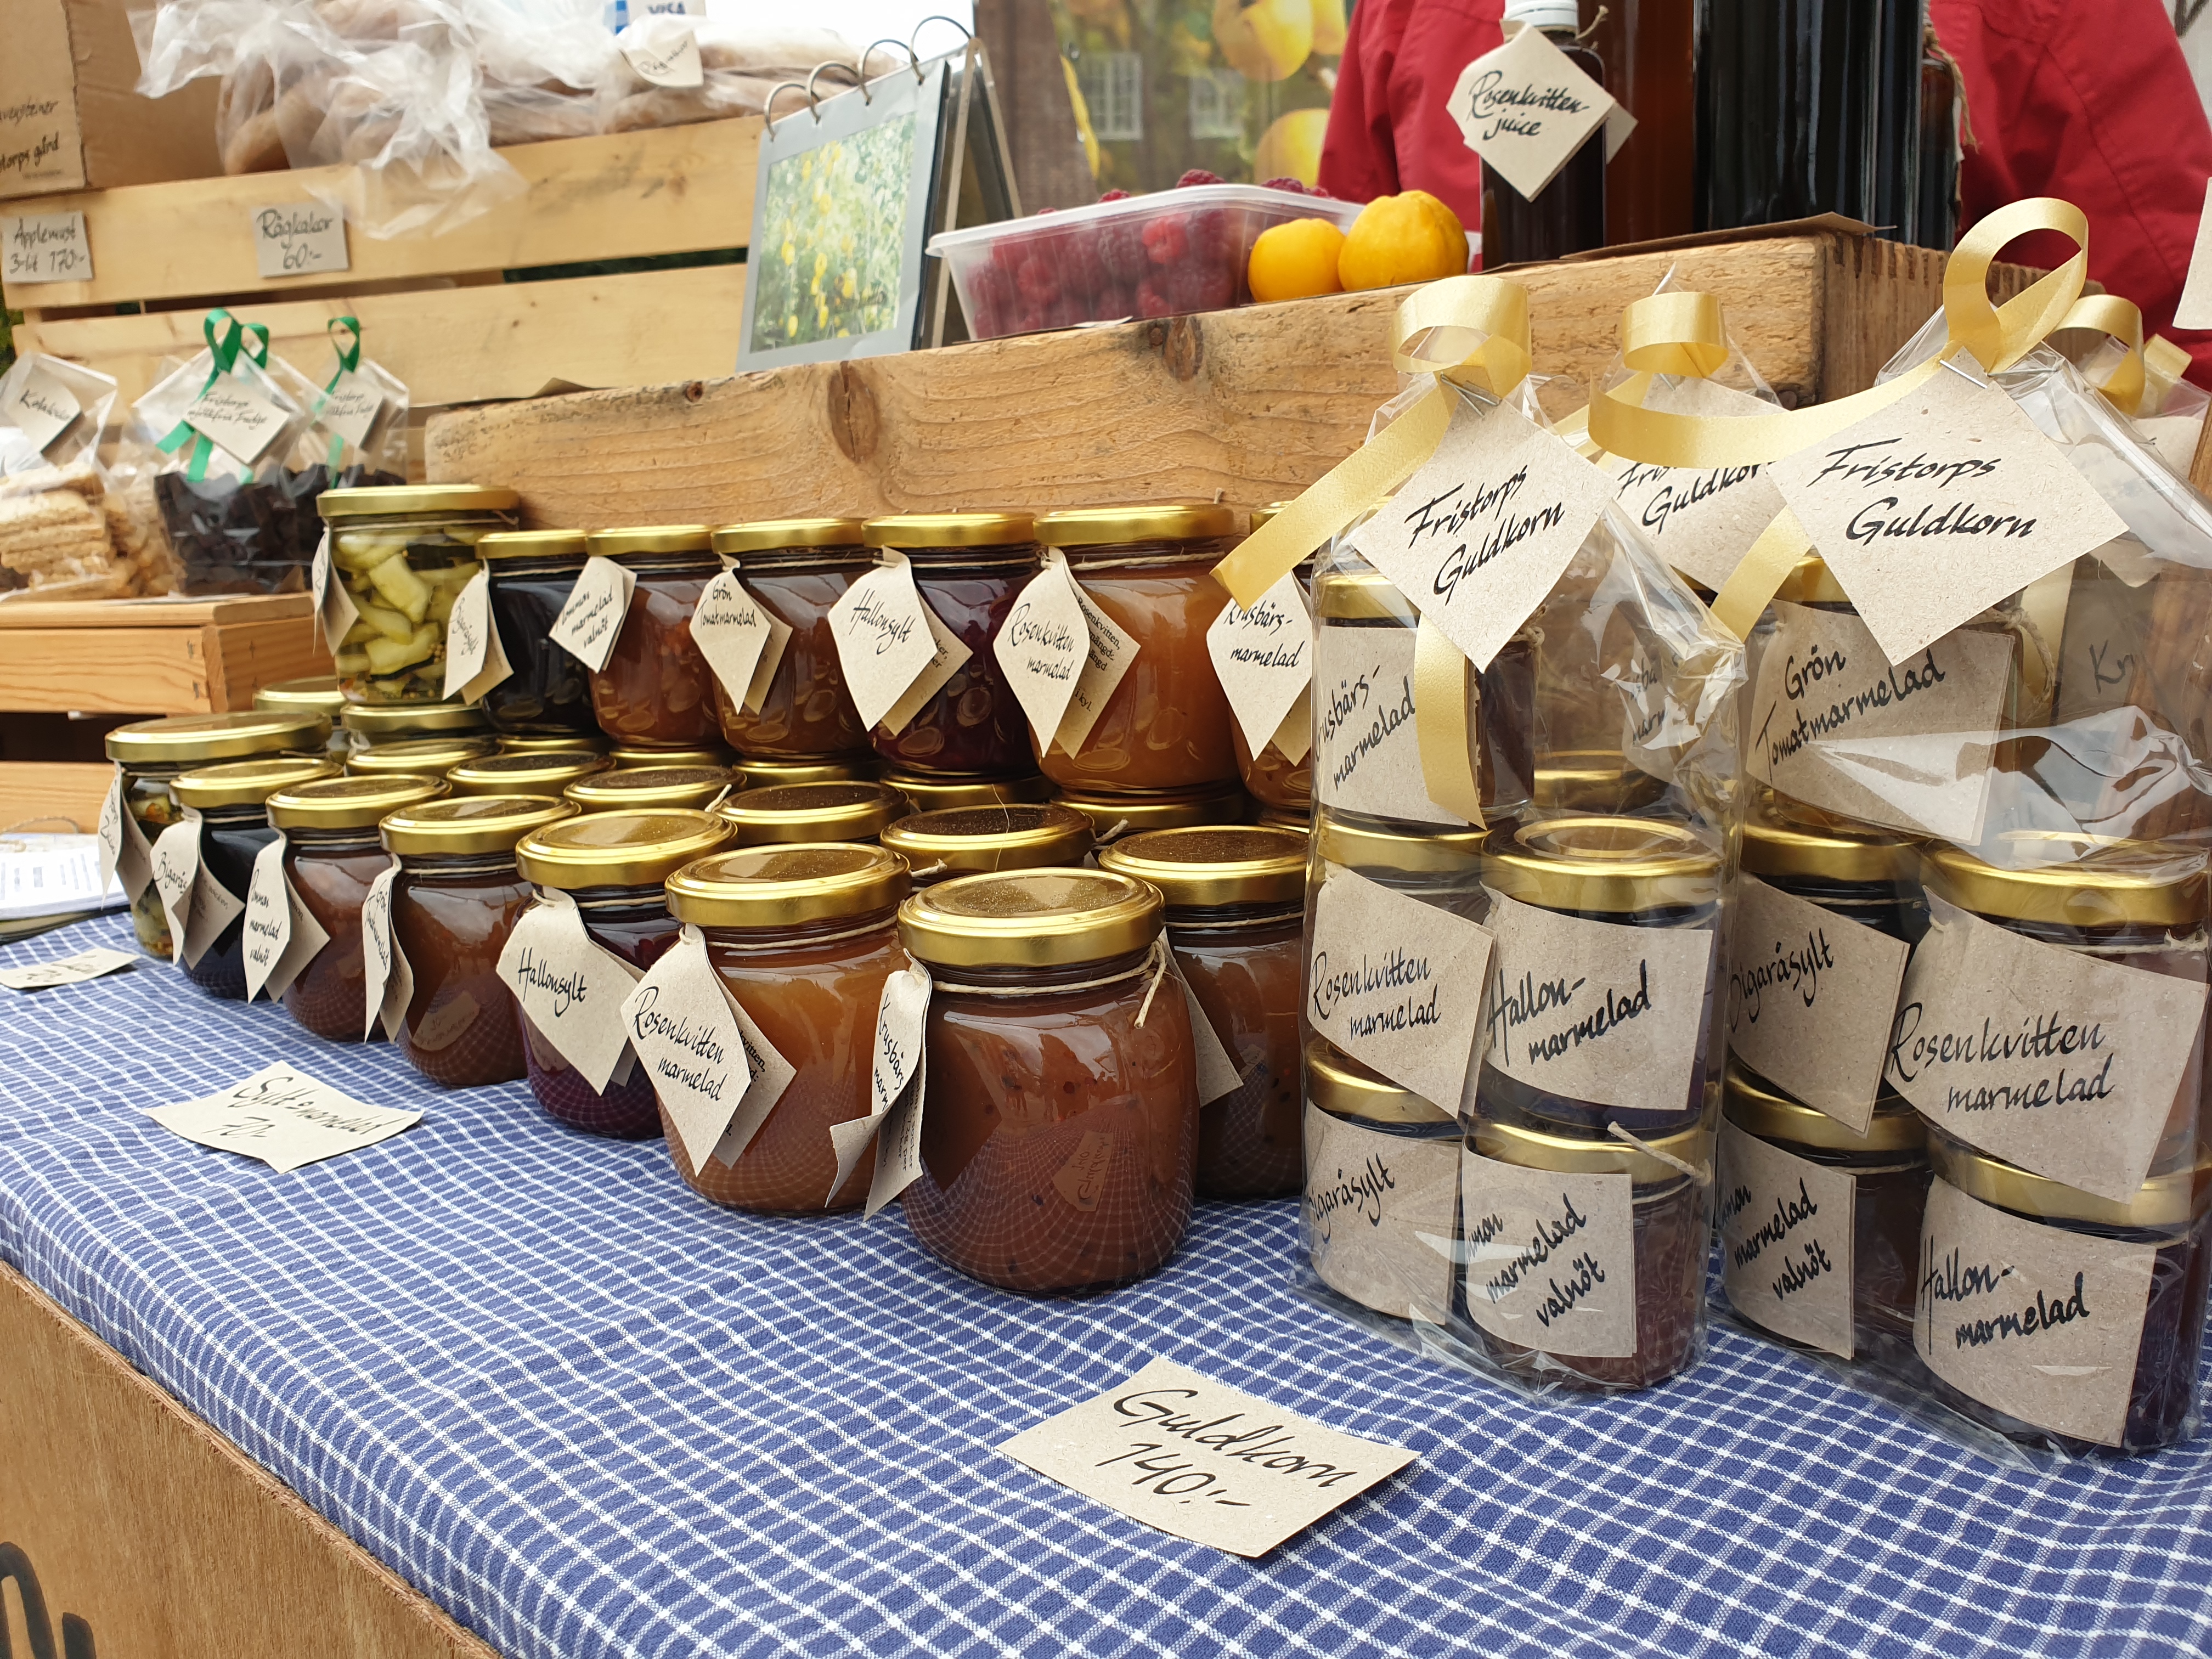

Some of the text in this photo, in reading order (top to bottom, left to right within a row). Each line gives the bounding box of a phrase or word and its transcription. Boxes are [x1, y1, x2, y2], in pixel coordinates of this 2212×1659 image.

[1483, 108, 1542, 141] juice
[1807, 437, 2002, 489] Fristorps
[1404, 464, 1528, 549] Fristorps
[1642, 464, 1762, 535] Guldkor
[1846, 496, 2038, 546] Guldkorn
[1432, 501, 1565, 607] Guldkorn
[697, 599, 757, 629] Tomatmarmelad
[712, 579, 733, 601] Grön
[849, 588, 916, 656] Hallonsylt
[1077, 596, 1121, 650] Rosenkvitten,
[1008, 602, 1075, 653] Rosenkvitten
[1088, 627, 1115, 661] mängd:
[1229, 640, 1305, 668] marmelad
[1026, 656, 1075, 681] marmelad
[1079, 693, 1092, 712] kyl.
[1785, 644, 1846, 701] Grön
[1315, 664, 1381, 763] rusbärs-
[1333, 675, 1416, 792] marmelad
[1754, 648, 1945, 785] Tomatmarmelad
[518, 946, 588, 1017] Hallonsylt
[1310, 946, 1431, 1020] Rosenkvitten
[1350, 983, 1442, 1041] marmelad
[1528, 958, 1652, 1066] marmelad
[632, 985, 724, 1064] Rosenkvitten
[1486, 967, 1587, 1068] Hallon-
[1891, 1002, 2107, 1082] Rosenkvitten
[228, 1076, 319, 1108] Sylt
[657, 1057, 727, 1102] marmelad
[1947, 1052, 2115, 1113] marmelad
[1486, 1192, 1587, 1305] marmelad
[1734, 1176, 1818, 1271] marmelad
[1536, 1251, 1605, 1327] valnöt
[1772, 1238, 1831, 1301] valnöt
[1921, 1234, 2015, 1356] Hallon-
[1955, 1271, 2091, 1350] marmelad
[1113, 1389, 1358, 1488] Guldkorn
[1094, 1442, 1252, 1506] 140:-
